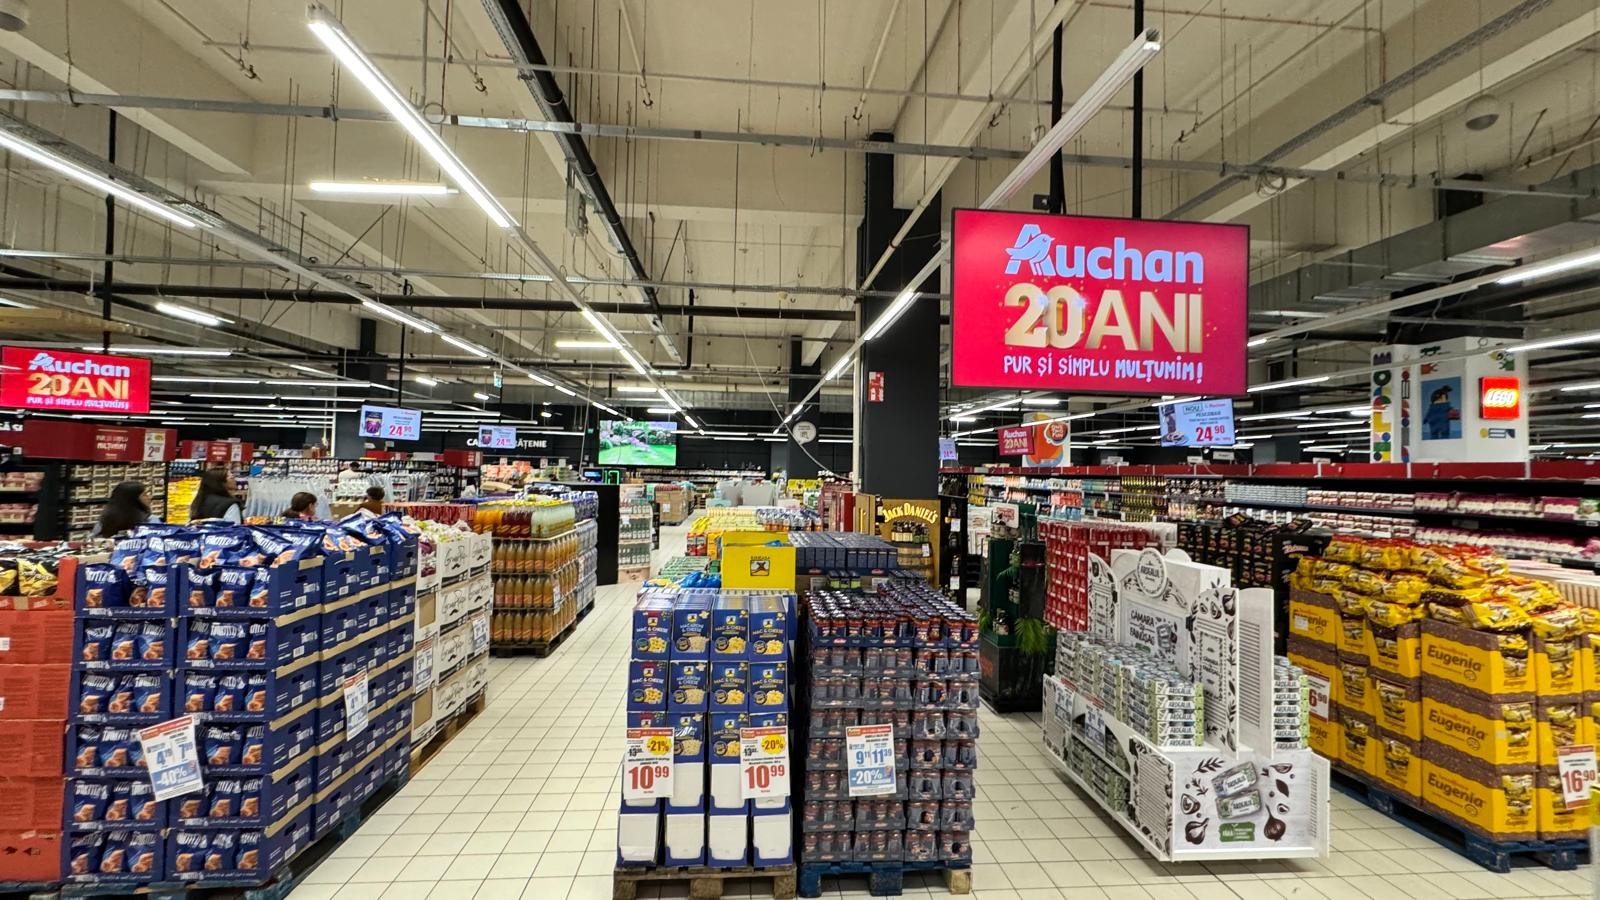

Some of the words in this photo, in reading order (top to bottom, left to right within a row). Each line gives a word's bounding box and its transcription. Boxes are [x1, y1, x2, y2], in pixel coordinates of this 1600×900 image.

[1004, 223, 1204, 284] Auchan
[1004, 282, 1086, 349] 20
[1085, 289, 1203, 354] ANI
[28, 352, 130, 377] Auchan
[1003, 354, 1032, 375] PUR
[1058, 355, 1109, 377] SIMPLU
[1115, 355, 1204, 384] MULȚUMIM!
[27, 372, 71, 396] 20
[70, 376, 129, 399] ANI
[1485, 389, 1516, 406] LEGO
[389, 424, 402, 436] 24
[1003, 429, 1026, 438] Auchan
[1195, 426, 1213, 441] 24
[1214, 425, 1225, 434] 90
[515, 438, 547, 449] ĂȚENIE
[1004, 438, 1014, 448] 20
[1013, 437, 1028, 448] ANI
[882, 505, 904, 523] JACK
[903, 502, 938, 524] DANIEL'S
[1427, 644, 1482, 672] Eugenia
[1309, 689, 1317, 707] 6
[1429, 709, 1485, 740] Eugenia
[647, 740, 670, 752] -21%
[761, 739, 784, 751] -20%
[856, 750, 865, 765] 9
[871, 749, 884, 764] 11
[157, 766, 187, 785] -40%
[628, 765, 654, 790] 10
[655, 765, 670, 778] 99
[744, 764, 770, 789] 10
[770, 764, 785, 777] 99
[851, 769, 883, 785] -20%
[1562, 769, 1583, 793] 16
[1583, 769, 1596, 781] 90
[1428, 772, 1483, 808] Eugenia
